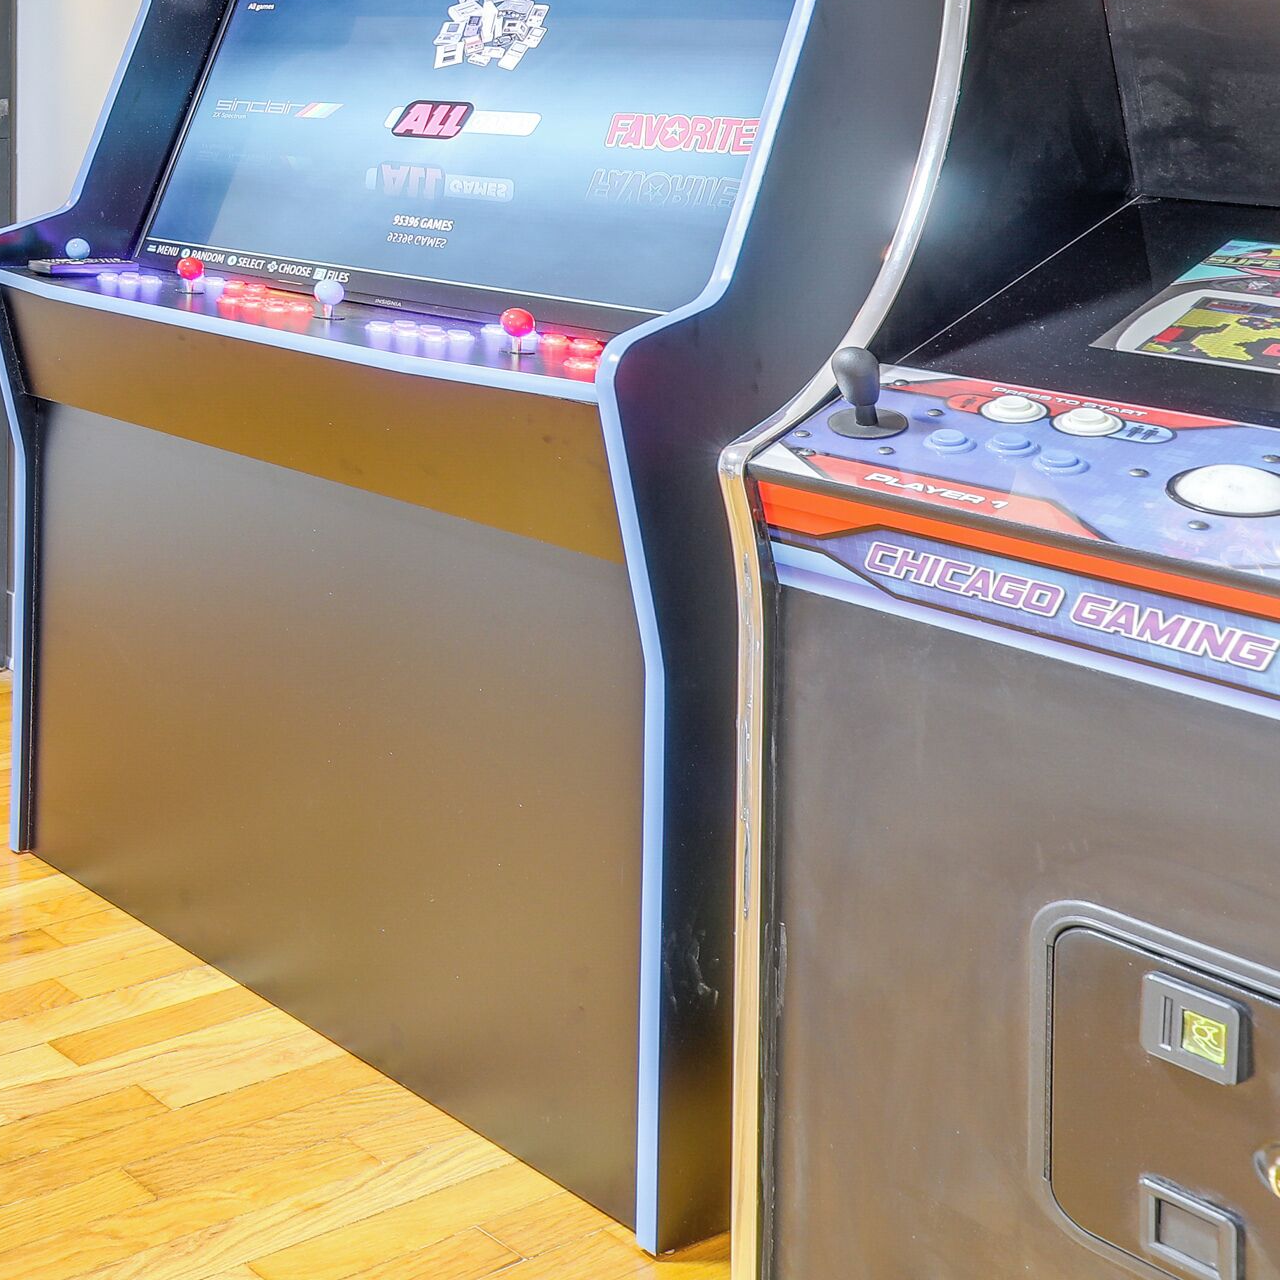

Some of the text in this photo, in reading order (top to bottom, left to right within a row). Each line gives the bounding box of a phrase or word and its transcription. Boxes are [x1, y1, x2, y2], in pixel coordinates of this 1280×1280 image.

[256, 4, 275, 12] games
[216, 98, 306, 115] sinclair
[392, 103, 469, 137] ALL
[393, 215, 454, 232] 95396 GAMES
[156, 245, 180, 257] MENU
[191, 250, 226, 264] RANDOM
[237, 257, 266, 270] SELECT
[278, 263, 313, 278] CHOOSE
[326, 271, 351, 283] FILES
[375, 299, 402, 308] INSIGNIA
[992, 387, 1148, 417] PRESS TO START
[864, 472, 1009, 509] PLAYER 1
[865, 541, 1280, 672] CHICAGO GAMING
